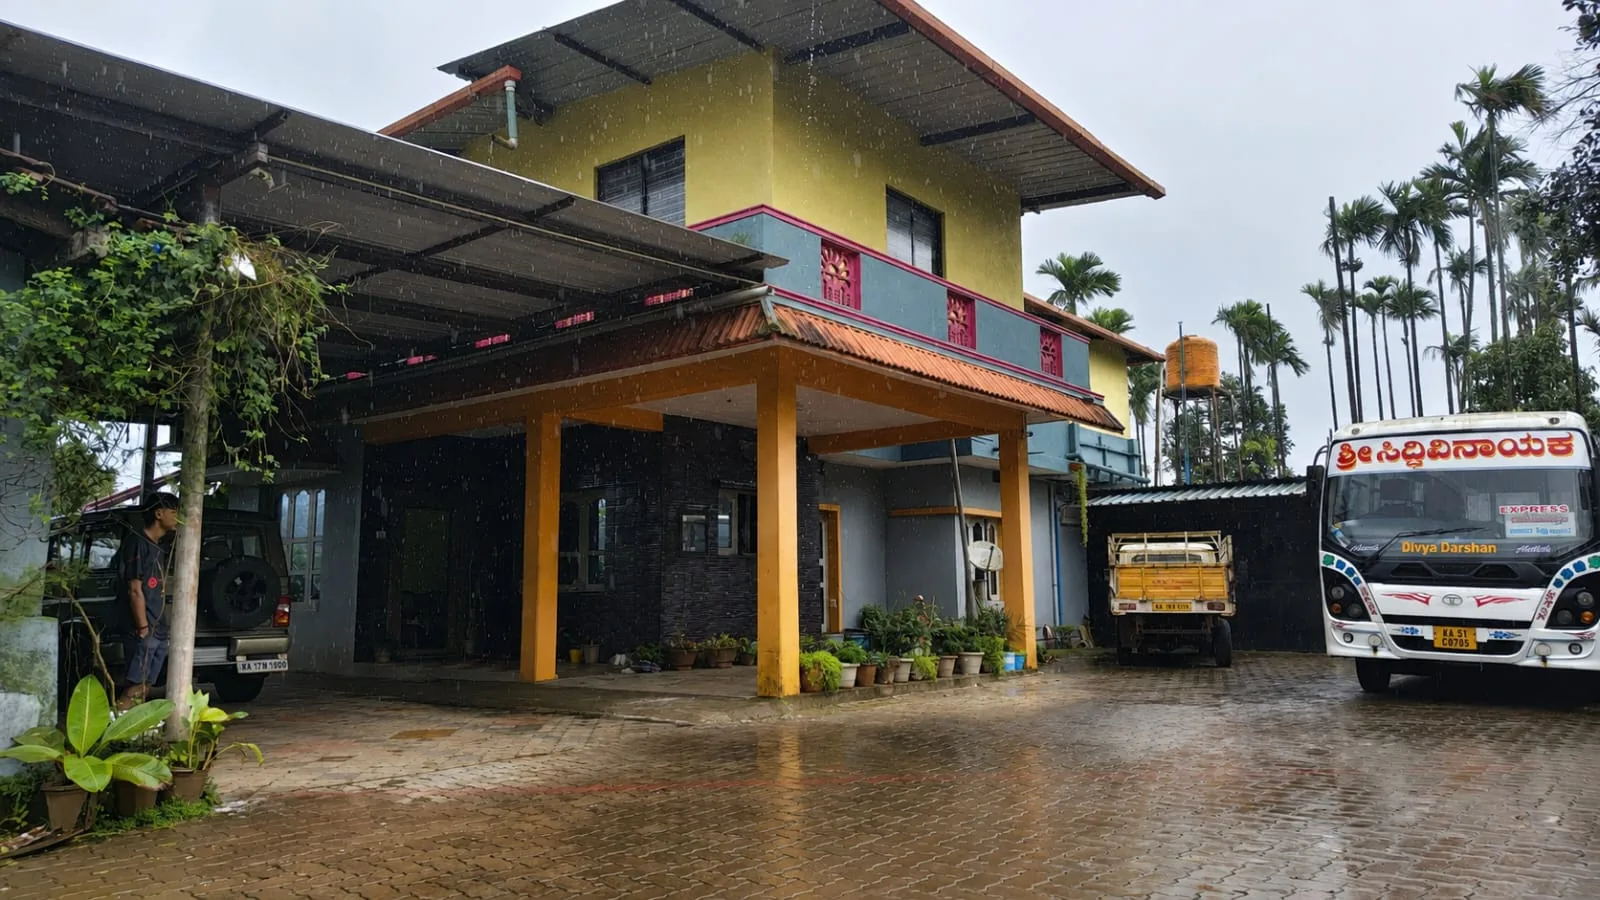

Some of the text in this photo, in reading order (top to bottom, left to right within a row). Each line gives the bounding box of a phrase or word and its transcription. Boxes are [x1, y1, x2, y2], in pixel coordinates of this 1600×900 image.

[1336, 442, 1372, 471] ಶ್ರೀ
[1499, 504, 1569, 514] EXPRESS
[1401, 541, 1497, 556] Divya Darshan
[1442, 627, 1468, 638] KA 51
